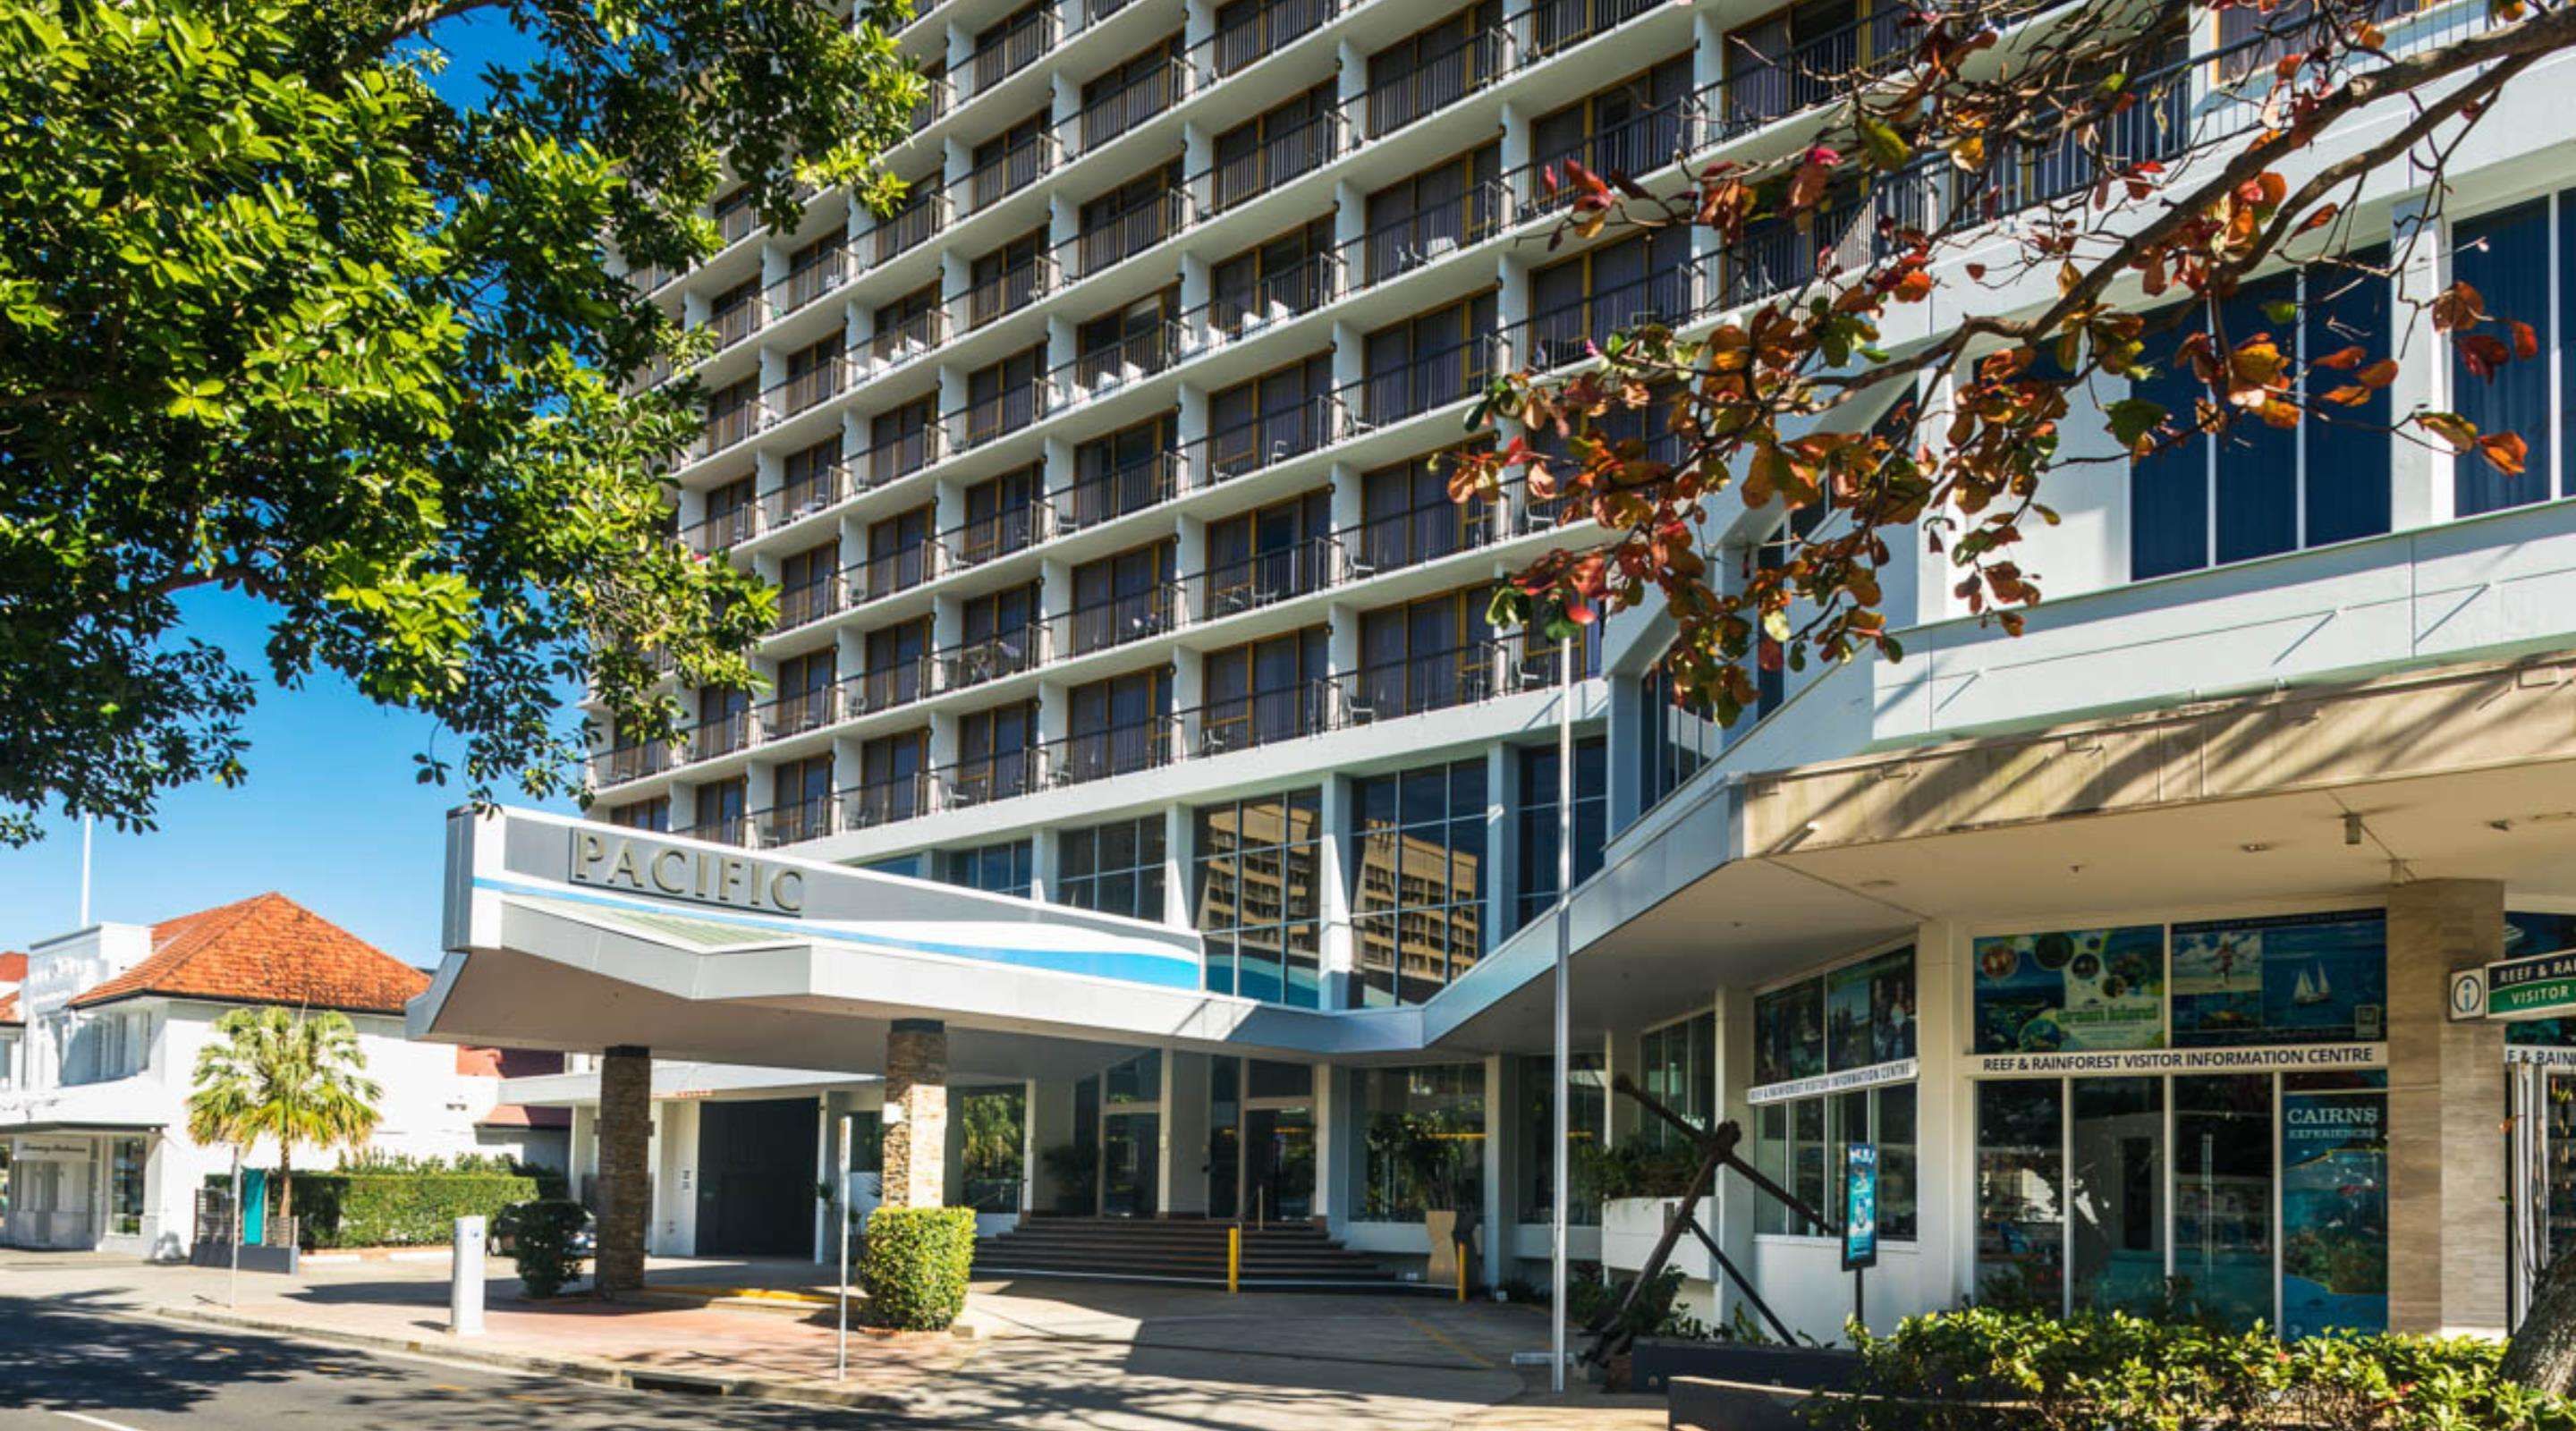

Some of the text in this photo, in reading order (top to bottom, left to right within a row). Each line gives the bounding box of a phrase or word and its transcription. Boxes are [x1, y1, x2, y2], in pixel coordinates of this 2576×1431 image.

[574, 831, 803, 912] PACIFIC
[2499, 967, 2531, 982] REEF
[2538, 963, 2547, 978] &
[2512, 985, 2569, 1005] VISITOR
[1983, 1047, 2373, 1071] REEF & RAINFOREST VISITOR INFORMATION CENTRE
[2287, 1107, 2378, 1125] CAIRNS
